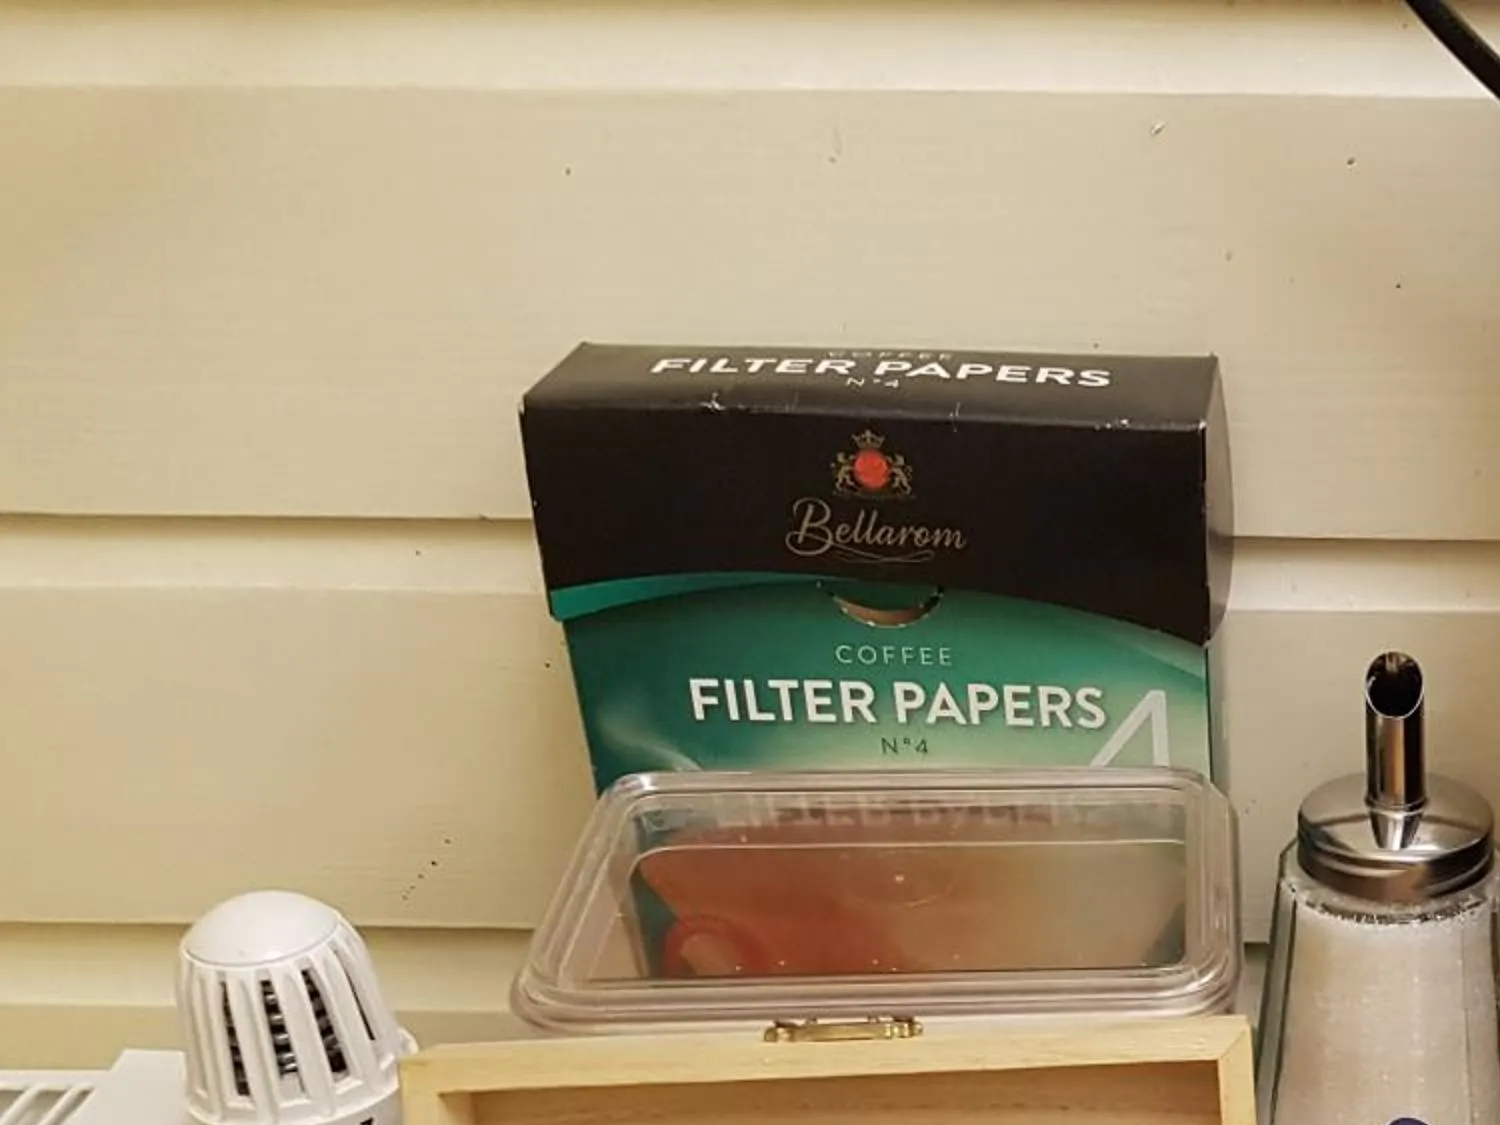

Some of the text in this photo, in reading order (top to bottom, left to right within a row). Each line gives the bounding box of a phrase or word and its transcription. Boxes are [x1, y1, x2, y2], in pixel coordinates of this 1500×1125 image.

[651, 358, 1110, 388] FILTER PAPERS
[785, 497, 967, 560] Bellarom
[835, 644, 953, 666] COFFEE
[689, 677, 1106, 730] FILTER PAPERS
